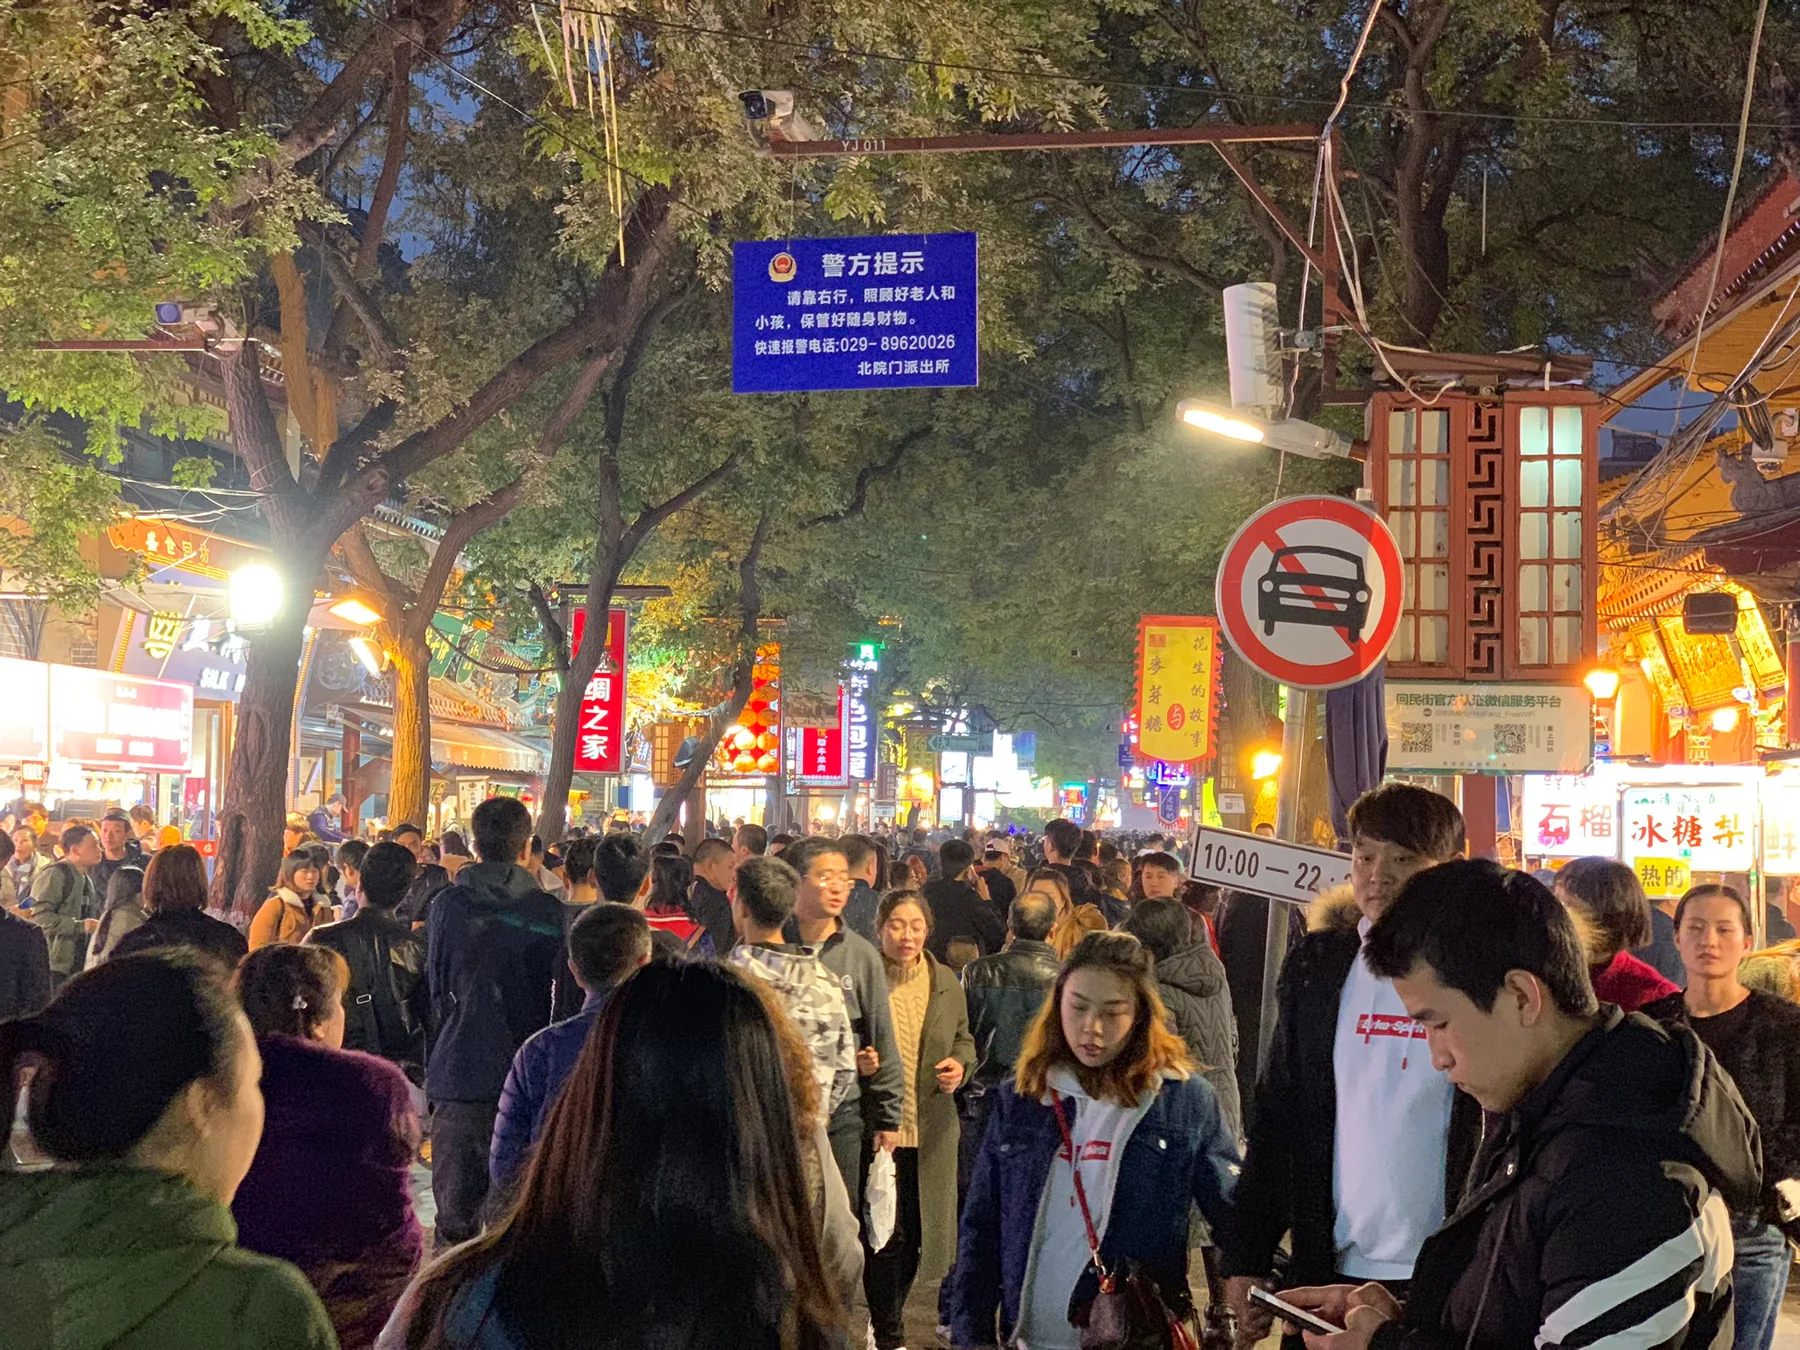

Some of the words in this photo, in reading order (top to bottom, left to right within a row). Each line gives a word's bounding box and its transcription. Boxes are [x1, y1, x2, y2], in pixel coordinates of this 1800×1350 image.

[821, 250, 926, 278] 警方提示
[787, 285, 956, 306] 请靠右行，照顾好老人和
[755, 310, 919, 330] 小孩，保管好随身财物。
[857, 359, 950, 376] 北院门派出所
[1189, 635, 1208, 748] 花生的故事
[1396, 693, 1562, 709] 回民街官方认证微信服务平台
[1170, 705, 1182, 729] 与
[1540, 803, 1612, 840] 石榴
[1631, 813, 1745, 848] 冰糖梨
[1204, 843, 1260, 879] 10:00
[1641, 865, 1684, 889] 热的
